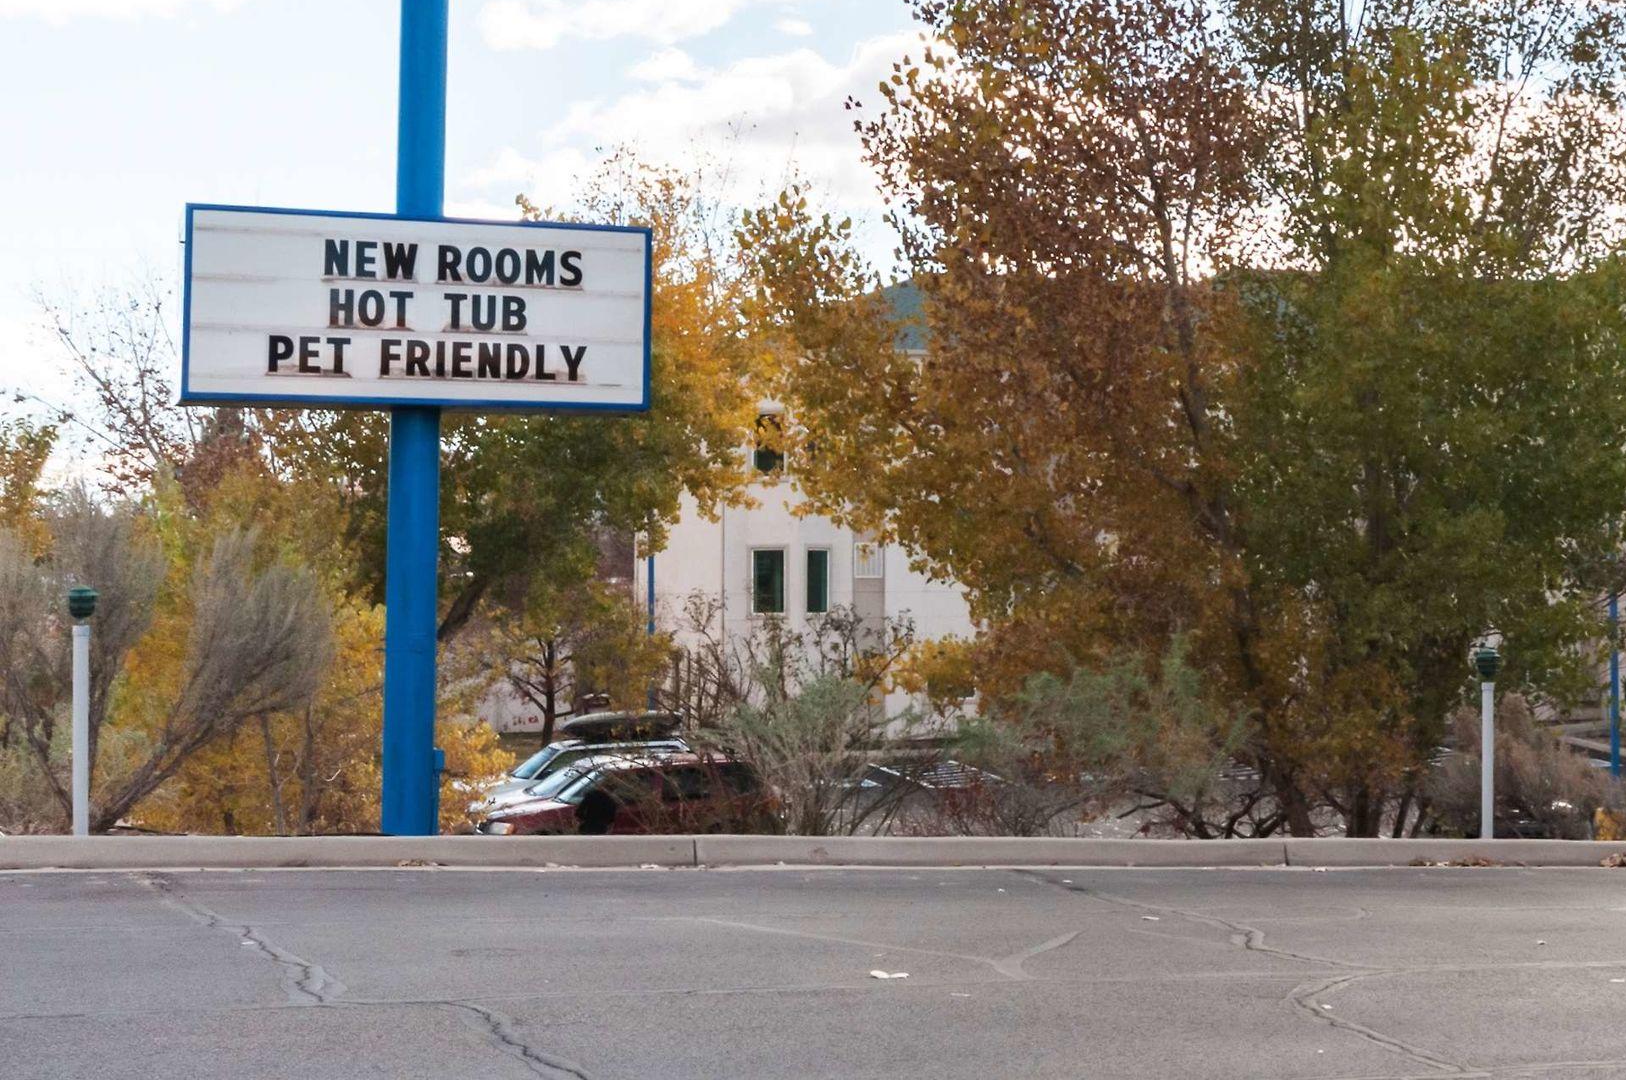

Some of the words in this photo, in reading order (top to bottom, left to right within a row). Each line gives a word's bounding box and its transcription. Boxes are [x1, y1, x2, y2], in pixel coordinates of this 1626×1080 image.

[324, 238, 418, 280] NEW
[437, 244, 583, 287] ROOMS
[329, 288, 414, 328] HOT
[444, 293, 527, 332] TUB
[268, 335, 351, 373] PET
[380, 338, 588, 382] FRIENDLY
